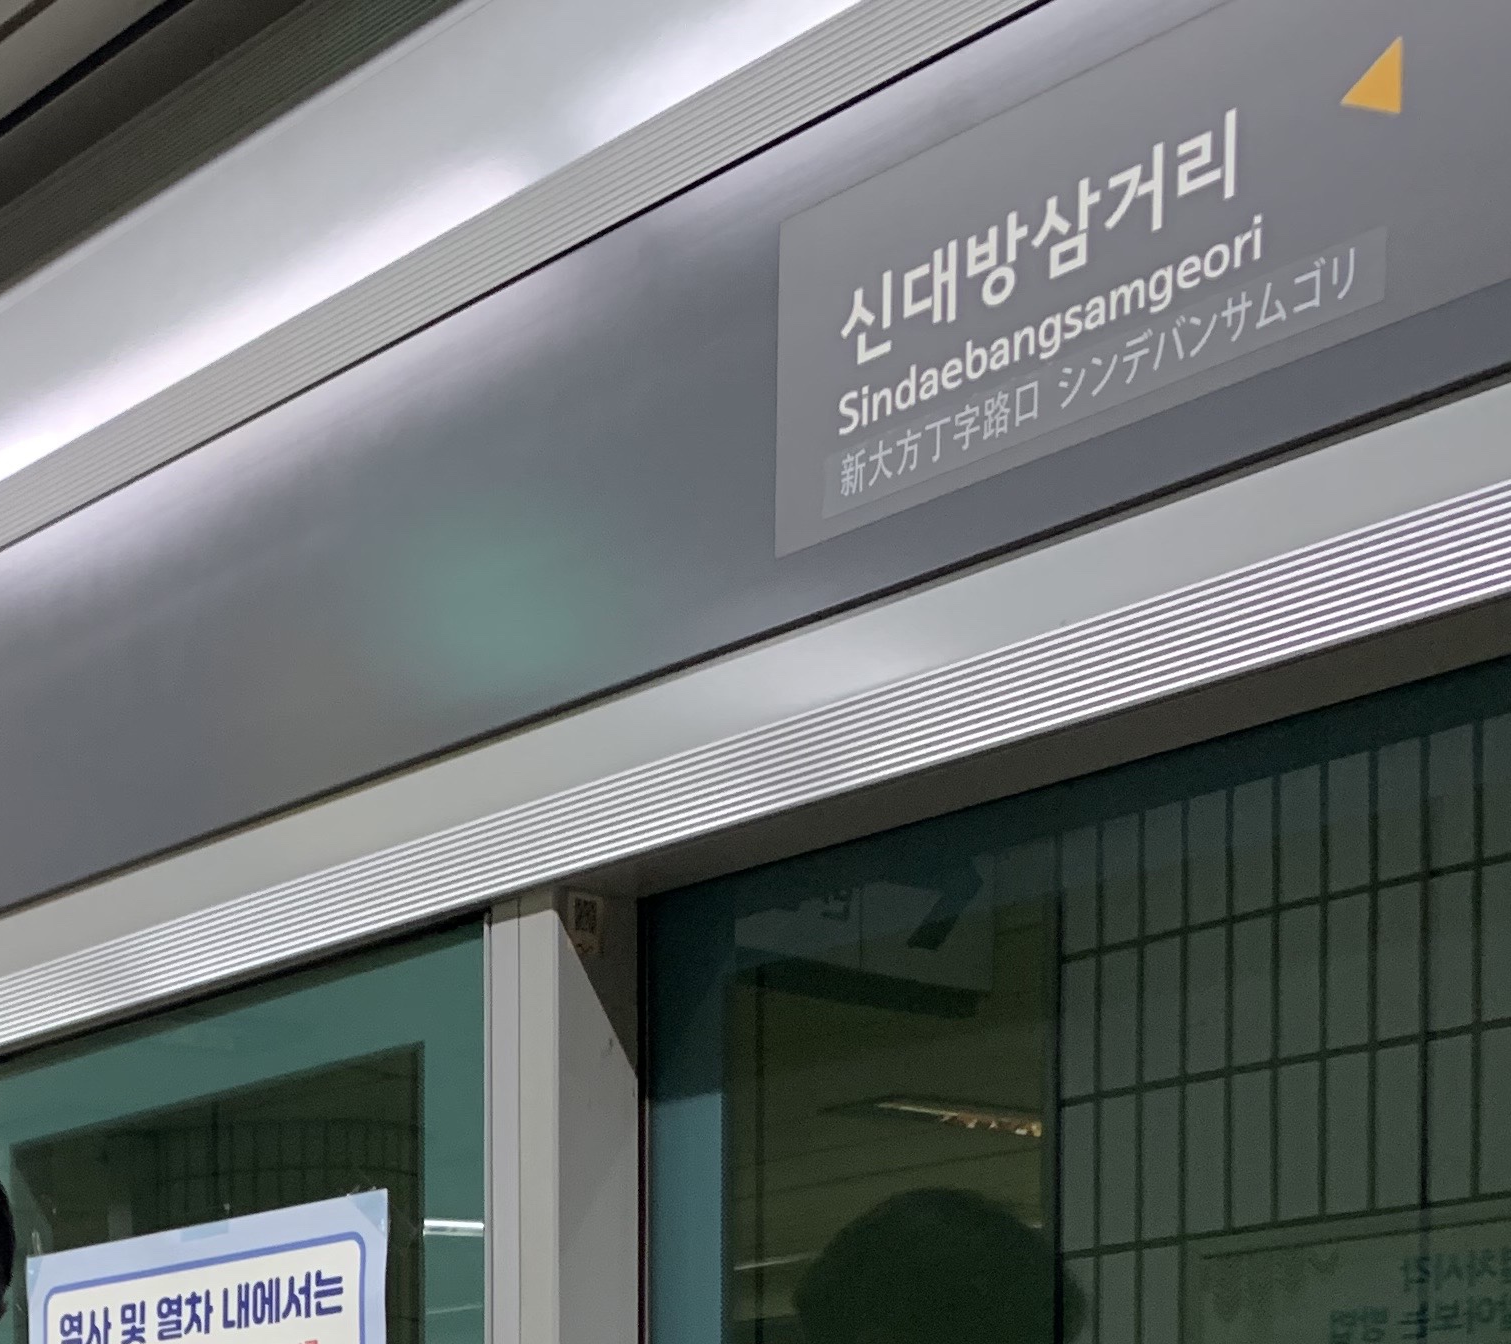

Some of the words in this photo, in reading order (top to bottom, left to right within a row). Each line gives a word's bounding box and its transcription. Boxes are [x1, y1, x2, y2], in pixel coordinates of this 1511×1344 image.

[836, 213, 1265, 437] Sindaebangsamgeori
[839, 107, 1239, 366] 신대방삼거리
[839, 380, 1039, 498] 新大方丁字路口
[1056, 247, 1357, 411] シンデバンサムゴリ
[157, 1290, 214, 1342] 열차
[222, 1270, 344, 1330] 내에서는
